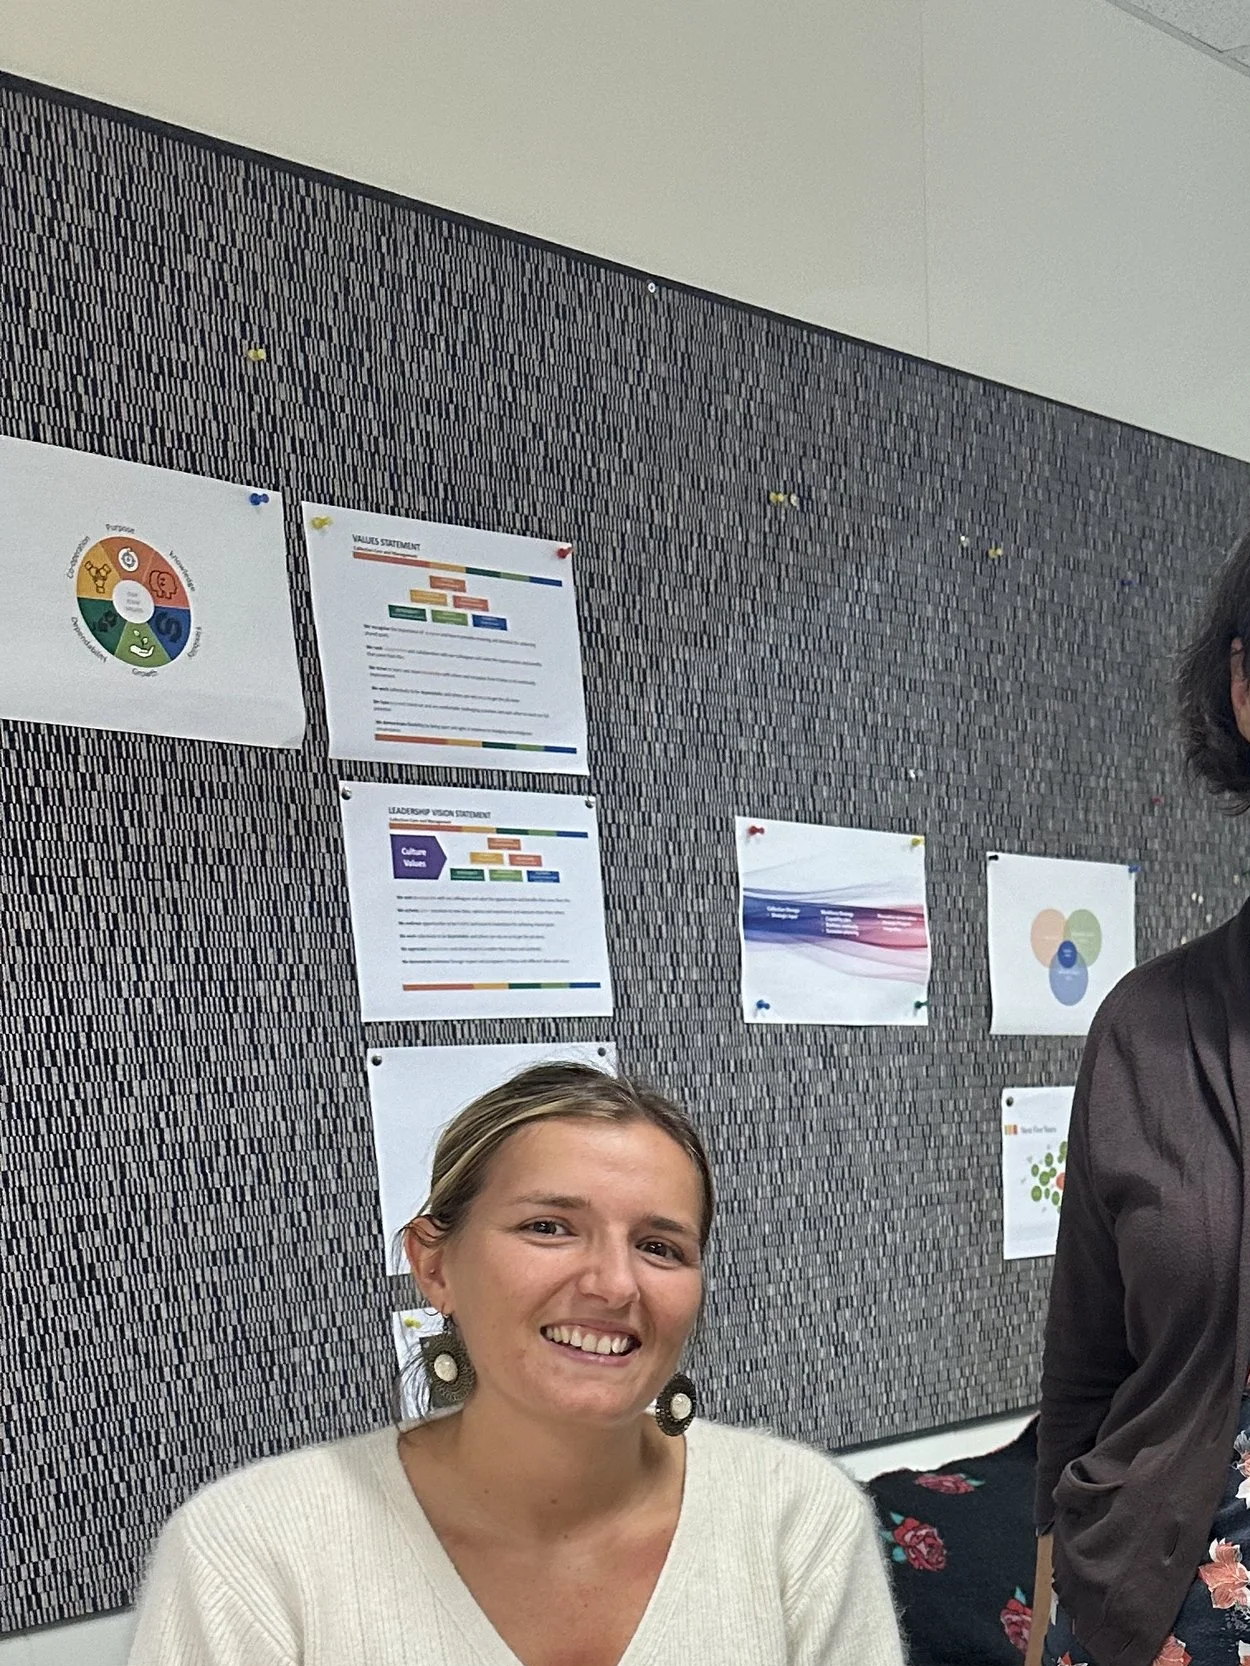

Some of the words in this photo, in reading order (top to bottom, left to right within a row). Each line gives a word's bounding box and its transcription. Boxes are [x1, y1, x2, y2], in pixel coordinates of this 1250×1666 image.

[352, 533, 380, 546] VALUES
[380, 538, 421, 551] STATEMENT
[388, 806, 431, 816] LEADERSHIP
[431, 808, 455, 817] VISION
[455, 809, 492, 819] STATEMENT
[401, 847, 427, 856] Culture
[403, 858, 427, 868] Values
